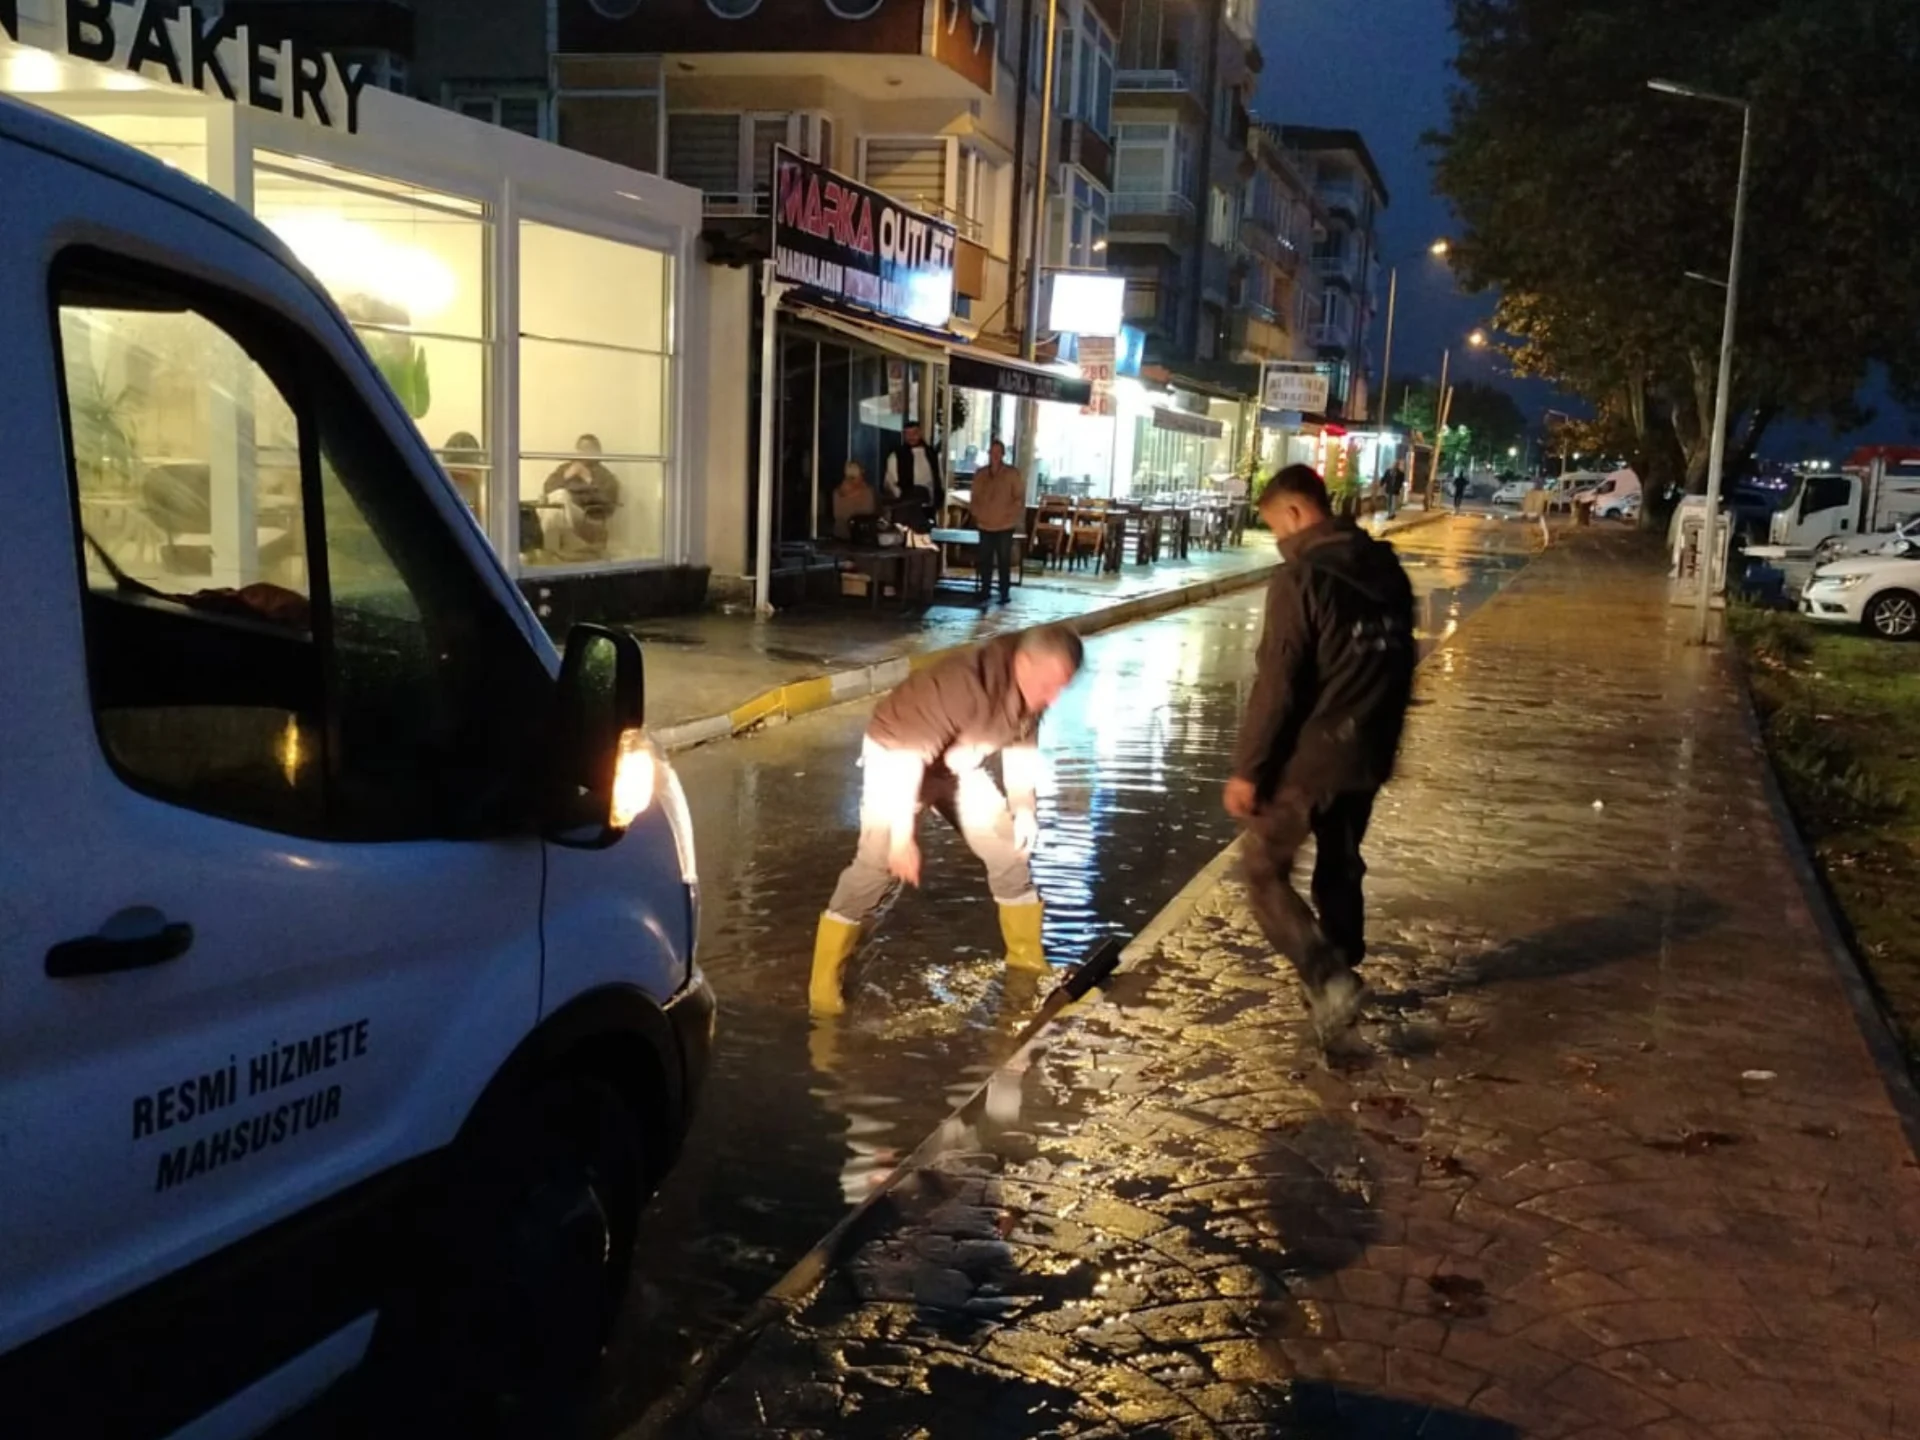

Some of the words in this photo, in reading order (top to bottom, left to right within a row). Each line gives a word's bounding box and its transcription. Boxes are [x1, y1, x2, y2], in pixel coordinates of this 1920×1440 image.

[66, 0, 366, 135] BAKERY
[778, 160, 875, 255] MARKA
[879, 206, 954, 272] OUTLET
[132, 1054, 237, 1140] RESMİ
[248, 1018, 369, 1096] HİZMETE
[155, 1085, 342, 1192] MAHSUSTUR
